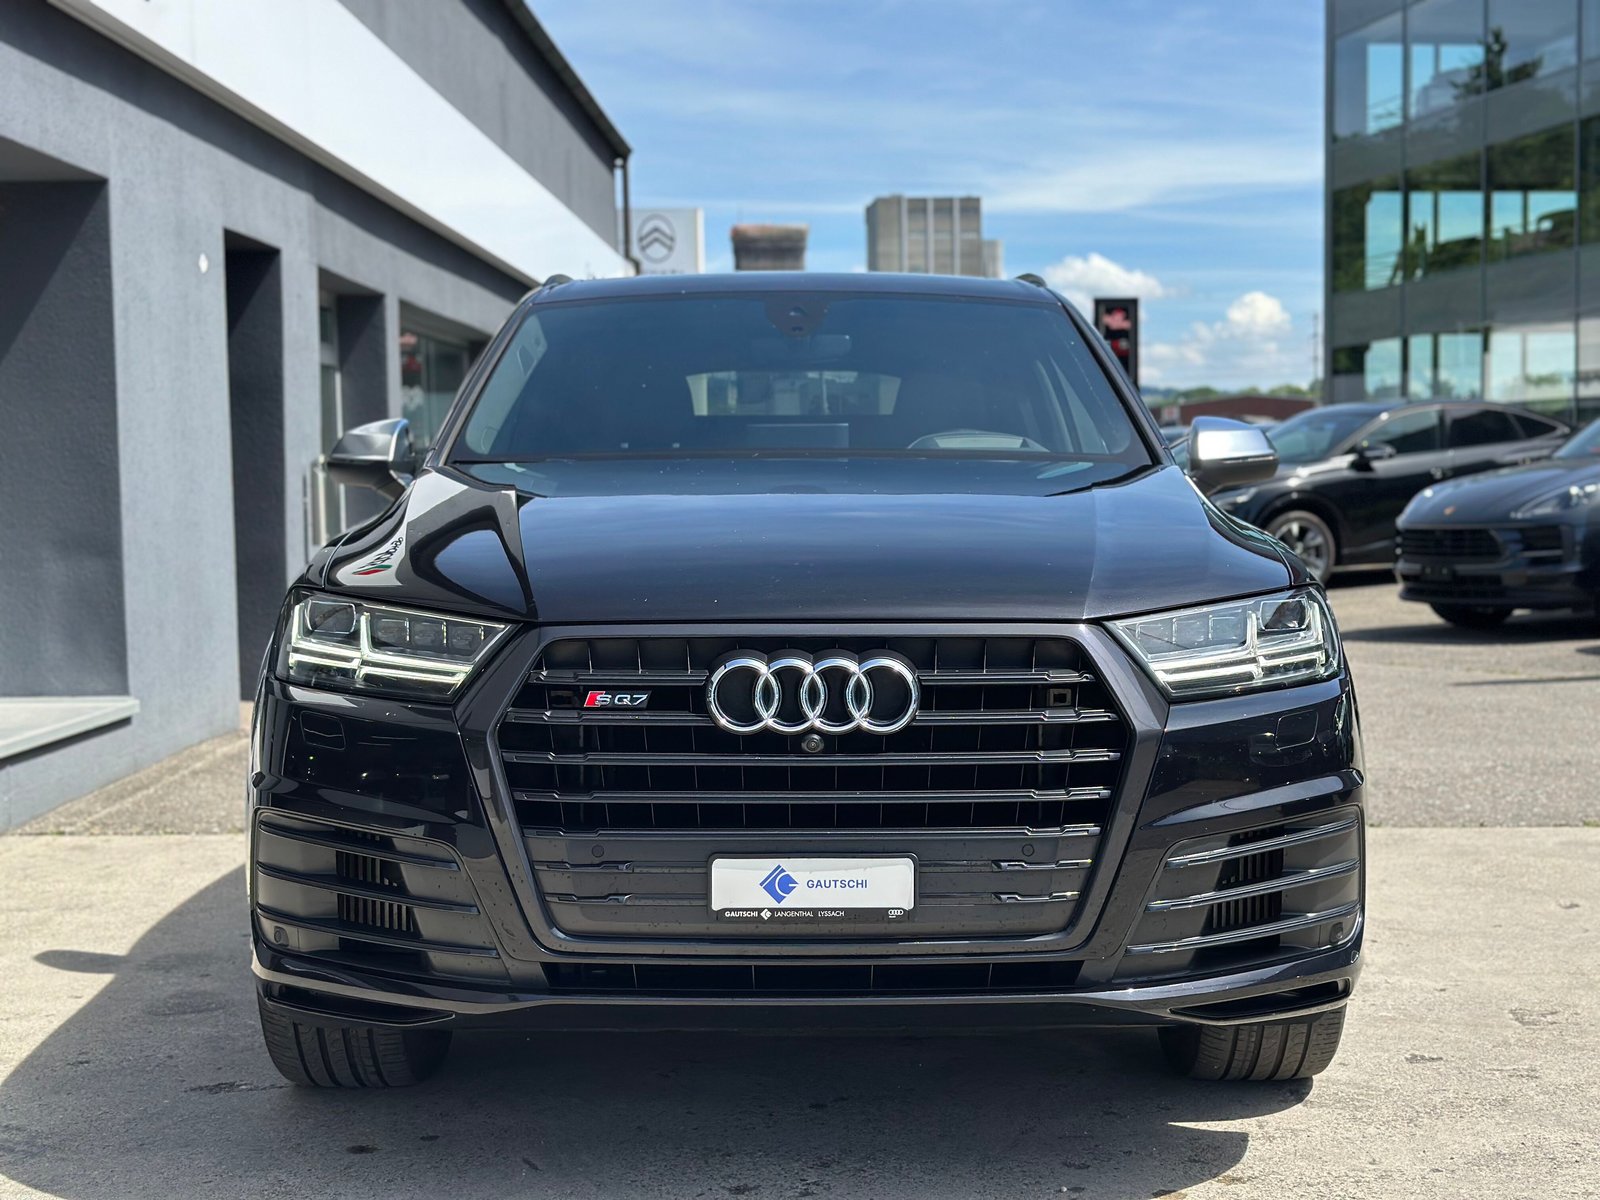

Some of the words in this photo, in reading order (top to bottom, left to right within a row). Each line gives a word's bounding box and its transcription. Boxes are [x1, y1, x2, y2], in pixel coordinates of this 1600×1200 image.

[594, 693, 649, 706] SQ7
[806, 879, 868, 889] GAUTSCHI
[724, 910, 759, 918] GAUTSCHI
[774, 910, 814, 918] LANGENTHAL
